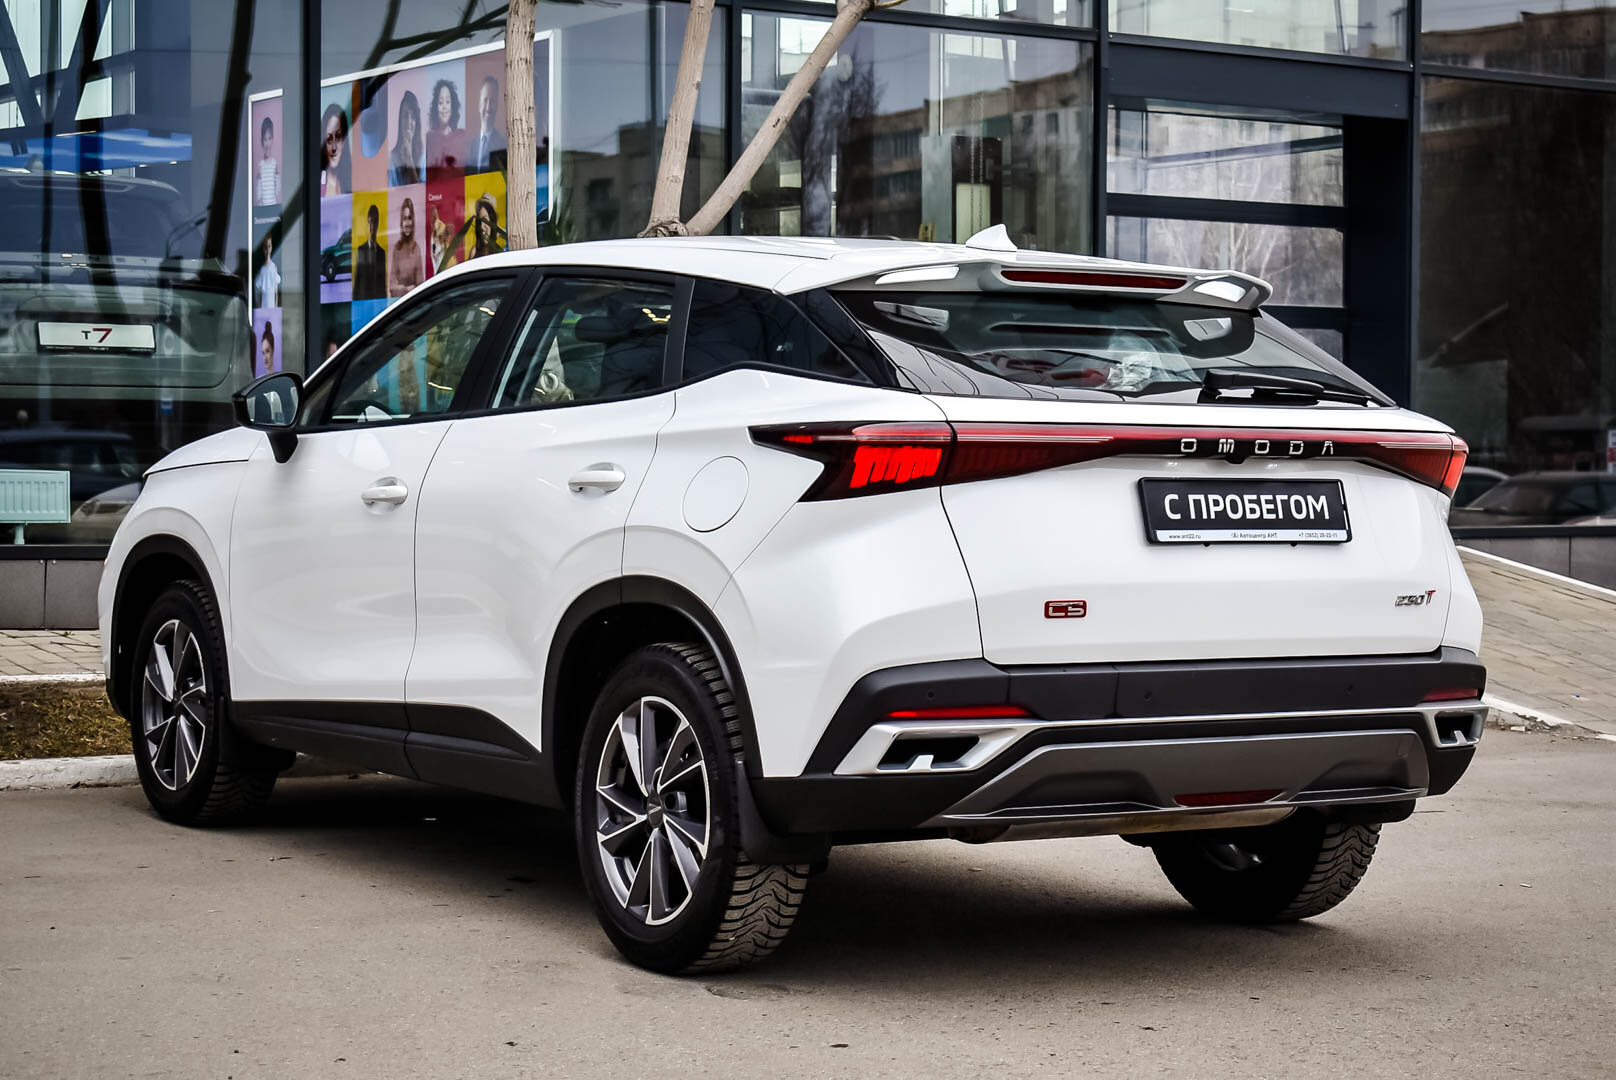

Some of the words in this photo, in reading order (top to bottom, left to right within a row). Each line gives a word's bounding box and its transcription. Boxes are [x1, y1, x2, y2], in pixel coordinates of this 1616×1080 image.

[81, 328, 112, 343] T7
[1180, 438, 1334, 455] OMODA
[1164, 494, 1181, 520] С
[1187, 494, 1330, 520] ПРОБЕГОМ
